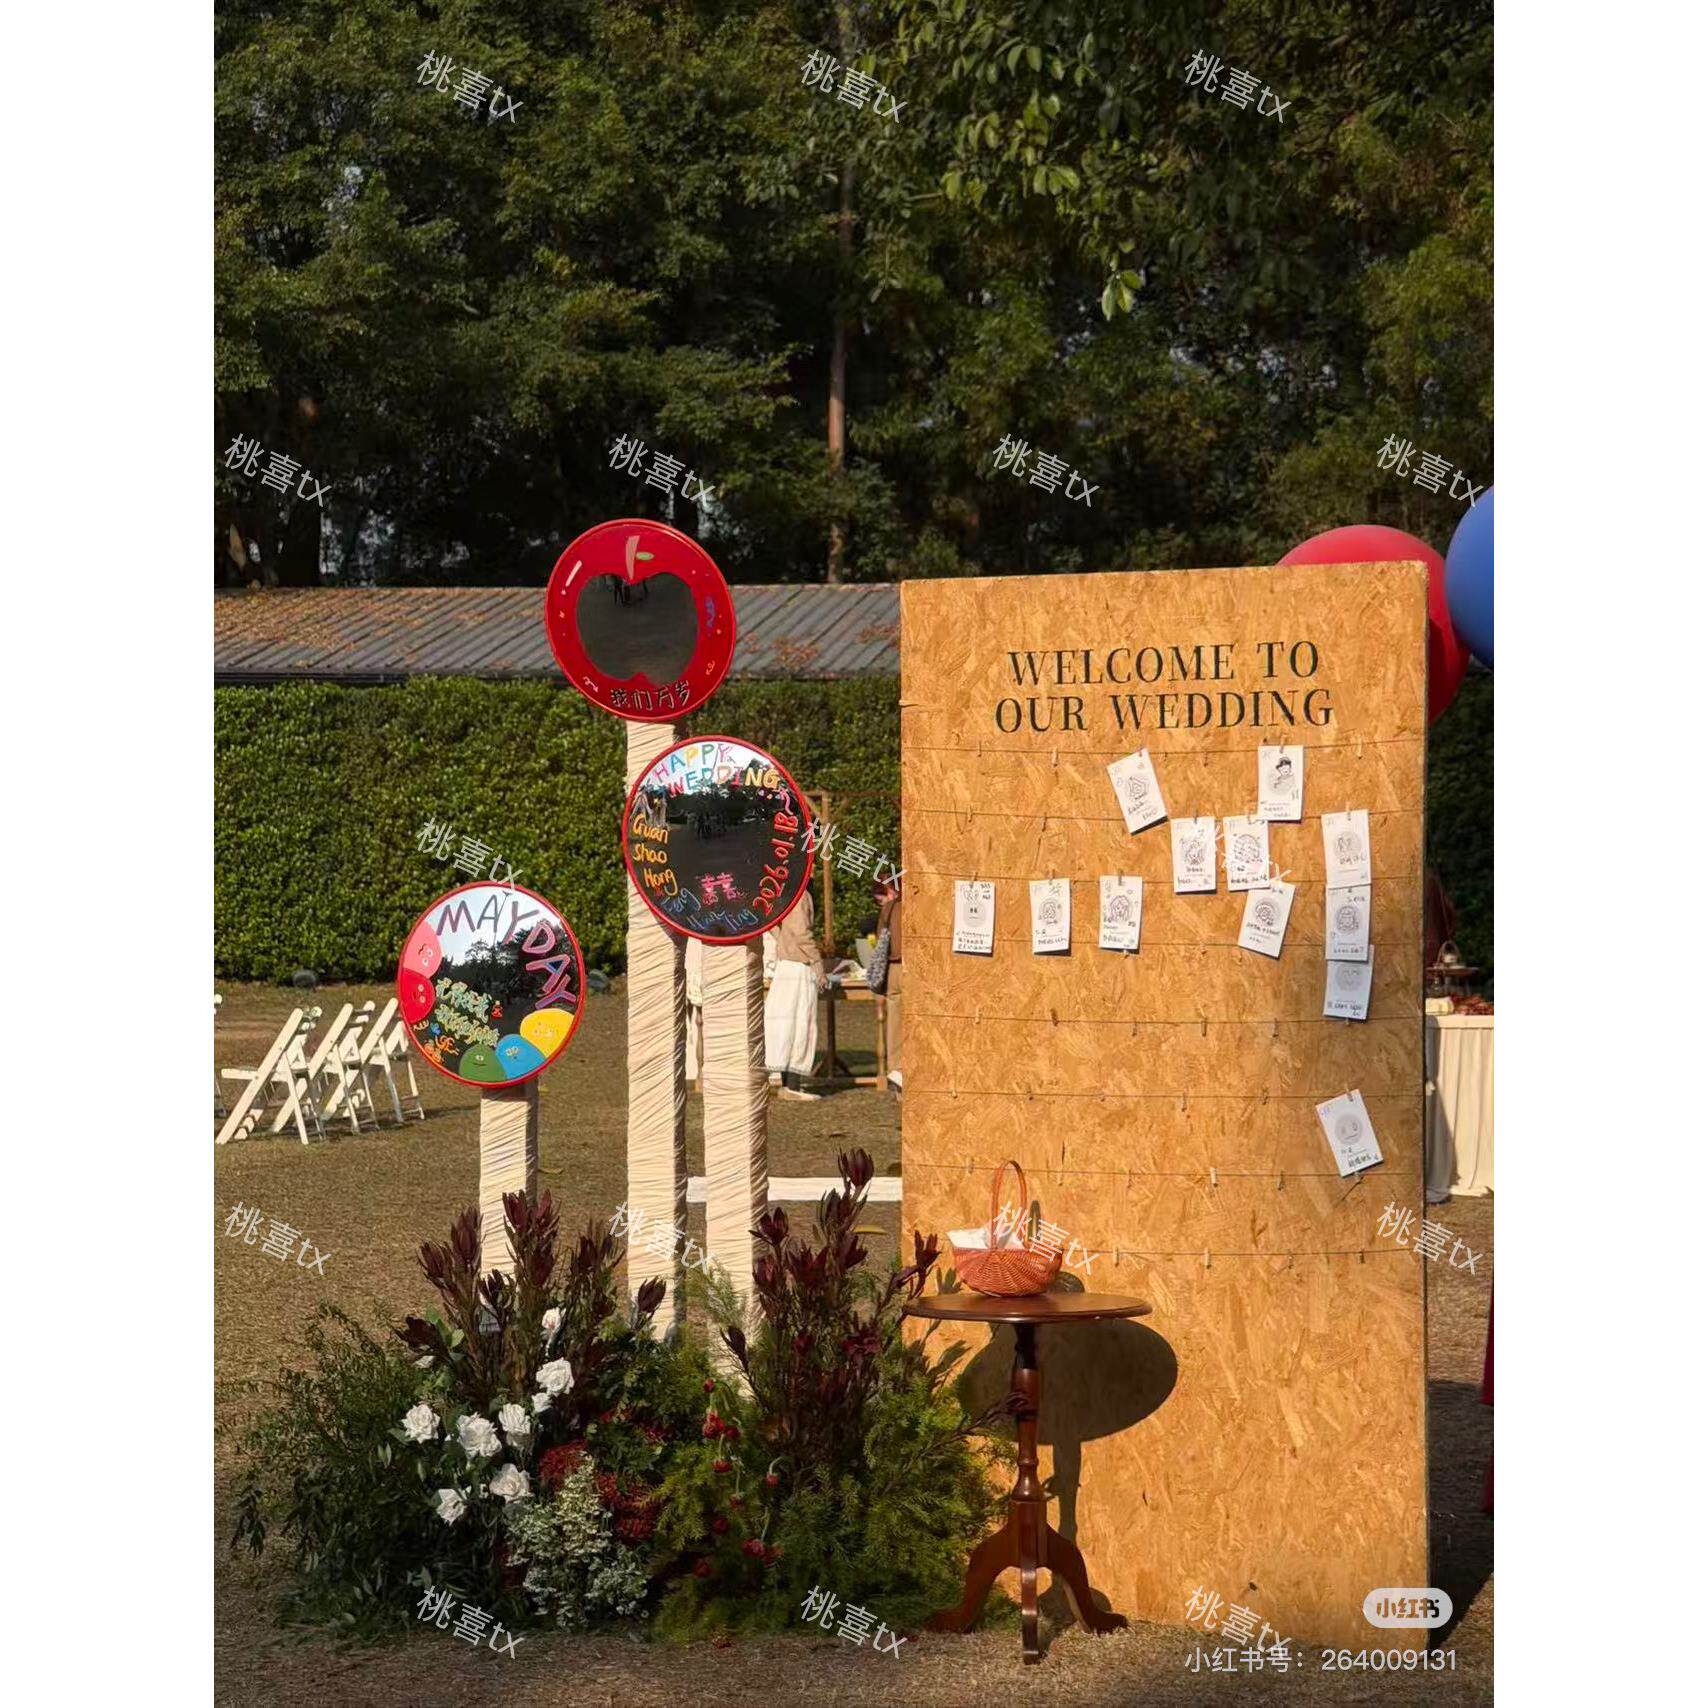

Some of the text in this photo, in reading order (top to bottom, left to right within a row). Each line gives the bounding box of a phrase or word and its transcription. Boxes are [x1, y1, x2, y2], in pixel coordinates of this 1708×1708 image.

[1007, 640, 1319, 686] WELCOME TO
[610, 680, 691, 711] 我们万岁
[995, 688, 1334, 734] OUR WEDDING
[653, 743, 732, 783] HAPPY
[667, 766, 780, 799] WEDDING
